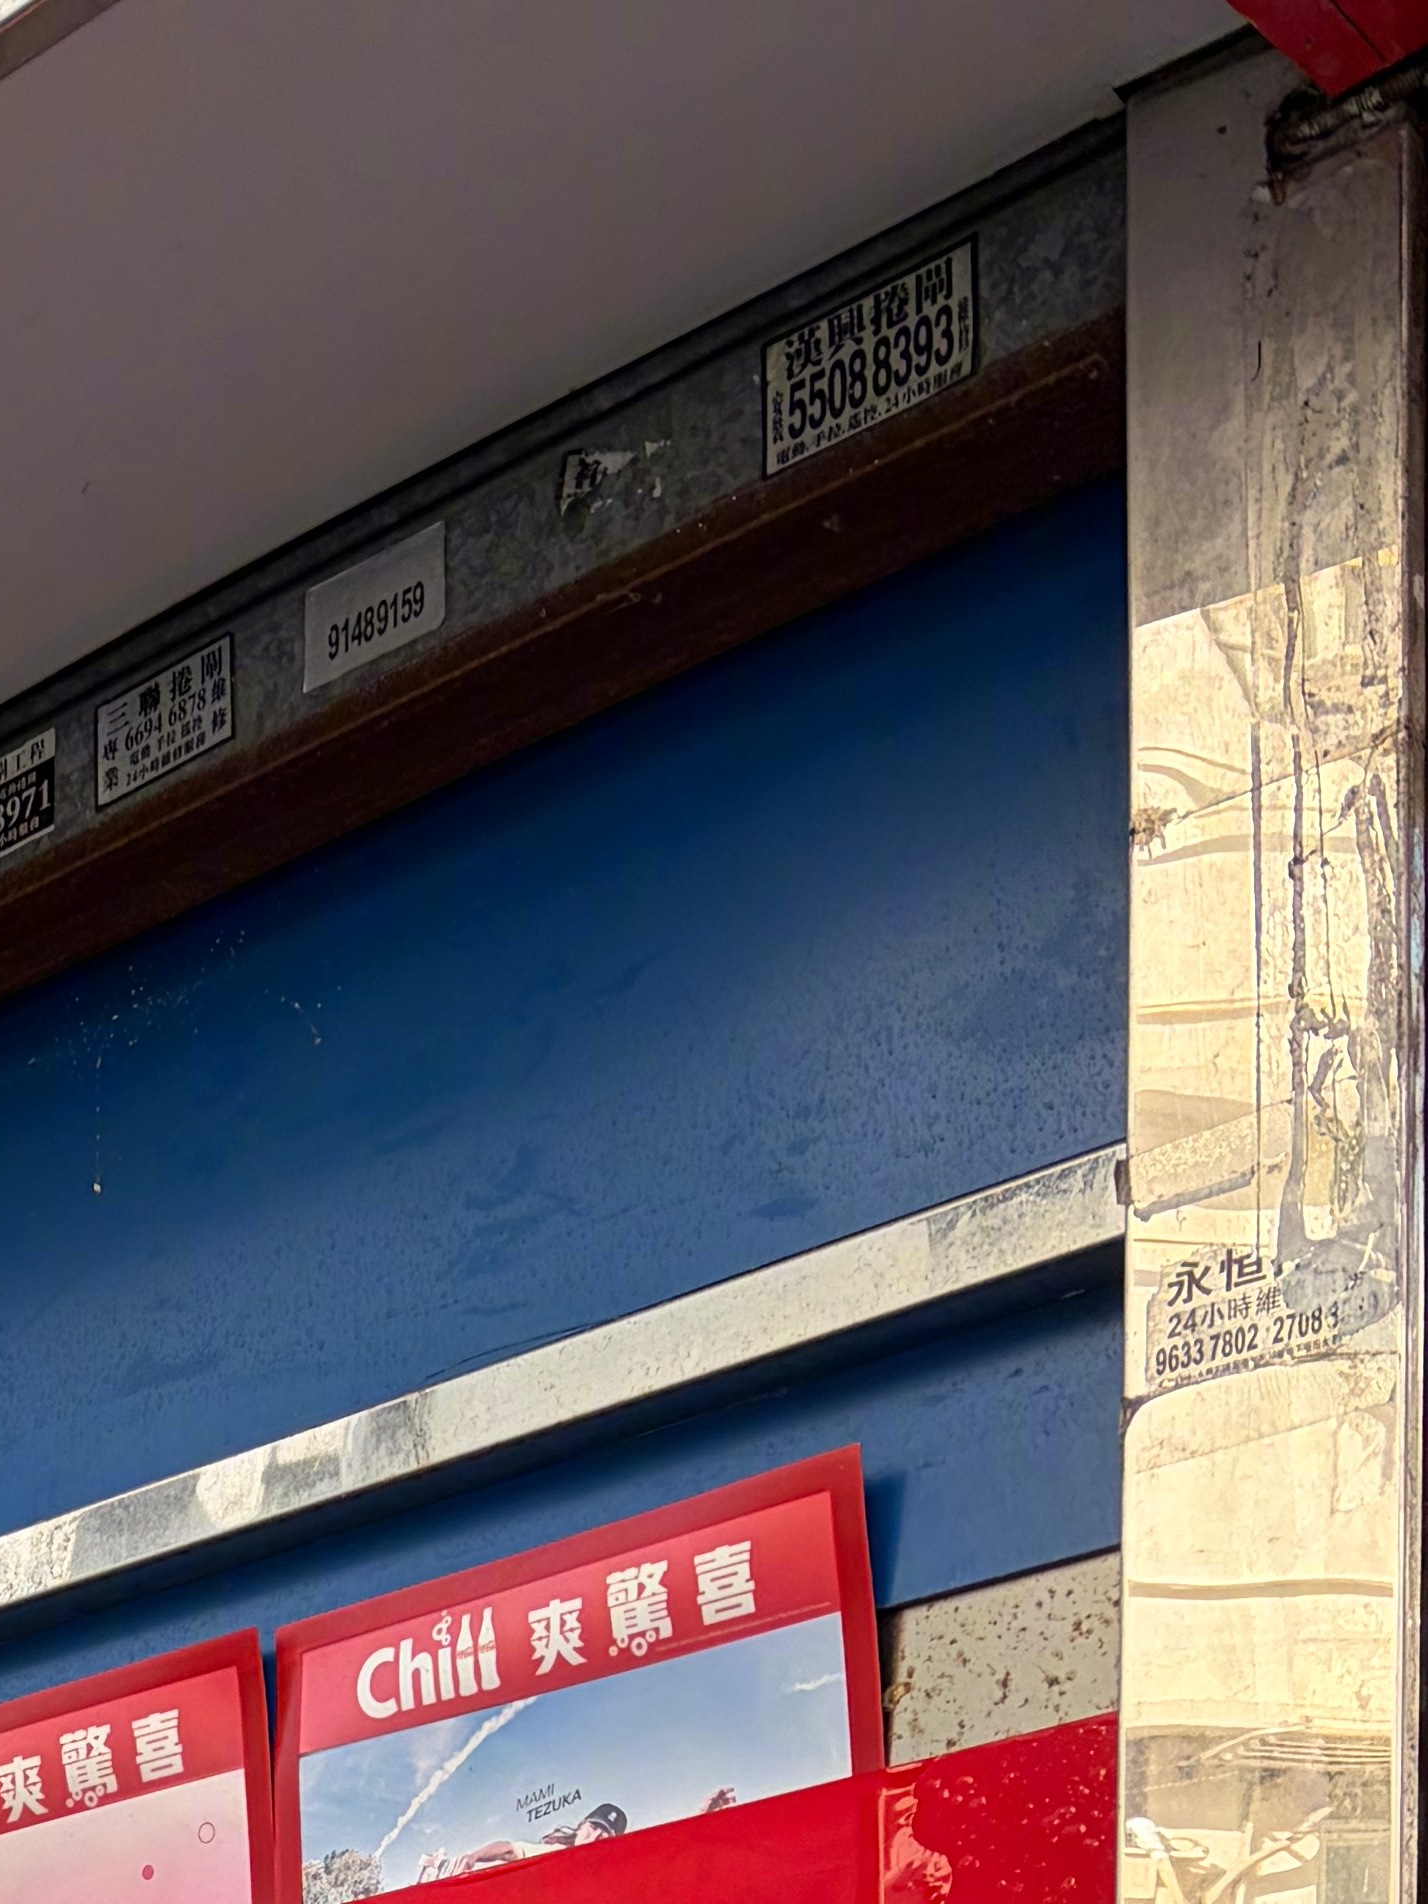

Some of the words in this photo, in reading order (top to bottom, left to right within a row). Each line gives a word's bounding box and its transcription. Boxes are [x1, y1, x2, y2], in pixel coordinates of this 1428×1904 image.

[788, 348, 868, 440] 5508
[872, 303, 955, 398] 8393
[327, 580, 426, 662] 91489159
[1155, 1340, 1205, 1377] 9633
[1209, 1325, 1259, 1362] 7802
[357, 1604, 502, 1721] Chill
[528, 1539, 759, 1677] 爽驚喜
[526, 1788, 582, 1823] TEZUKA
